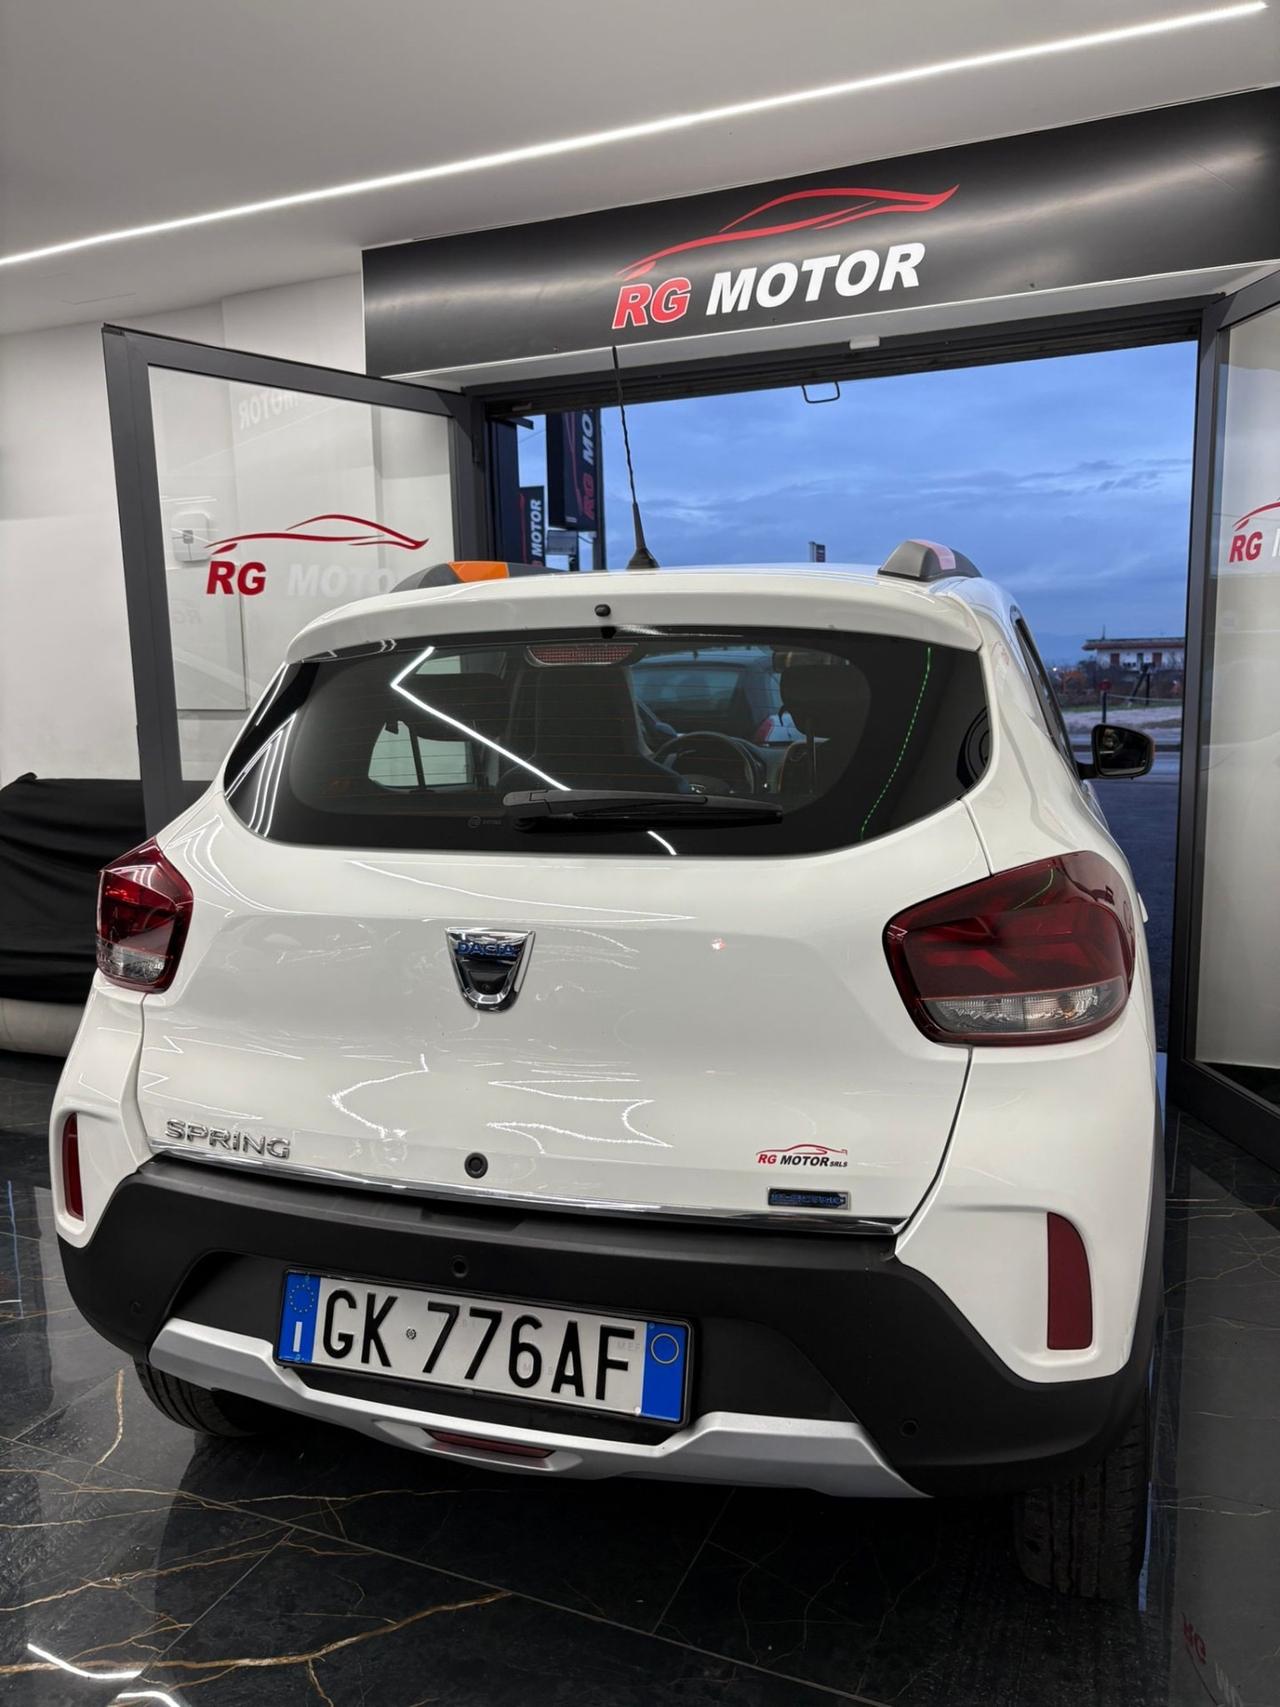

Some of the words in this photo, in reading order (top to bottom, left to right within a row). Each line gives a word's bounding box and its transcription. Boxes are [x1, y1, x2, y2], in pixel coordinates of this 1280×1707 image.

[611, 277, 692, 330] RG
[705, 242, 926, 316] MOTOR
[581, 409, 594, 465] MO
[530, 499, 543, 557] MOTOR
[1229, 531, 1263, 563] RG
[206, 561, 267, 596] RG
[287, 564, 397, 597] MOTO
[164, 1119, 291, 1160] SPRING
[758, 1154, 777, 1165] RG
[780, 1155, 830, 1167] MOTOR
[322, 1288, 399, 1368] GK
[422, 1300, 635, 1401] 776AF
